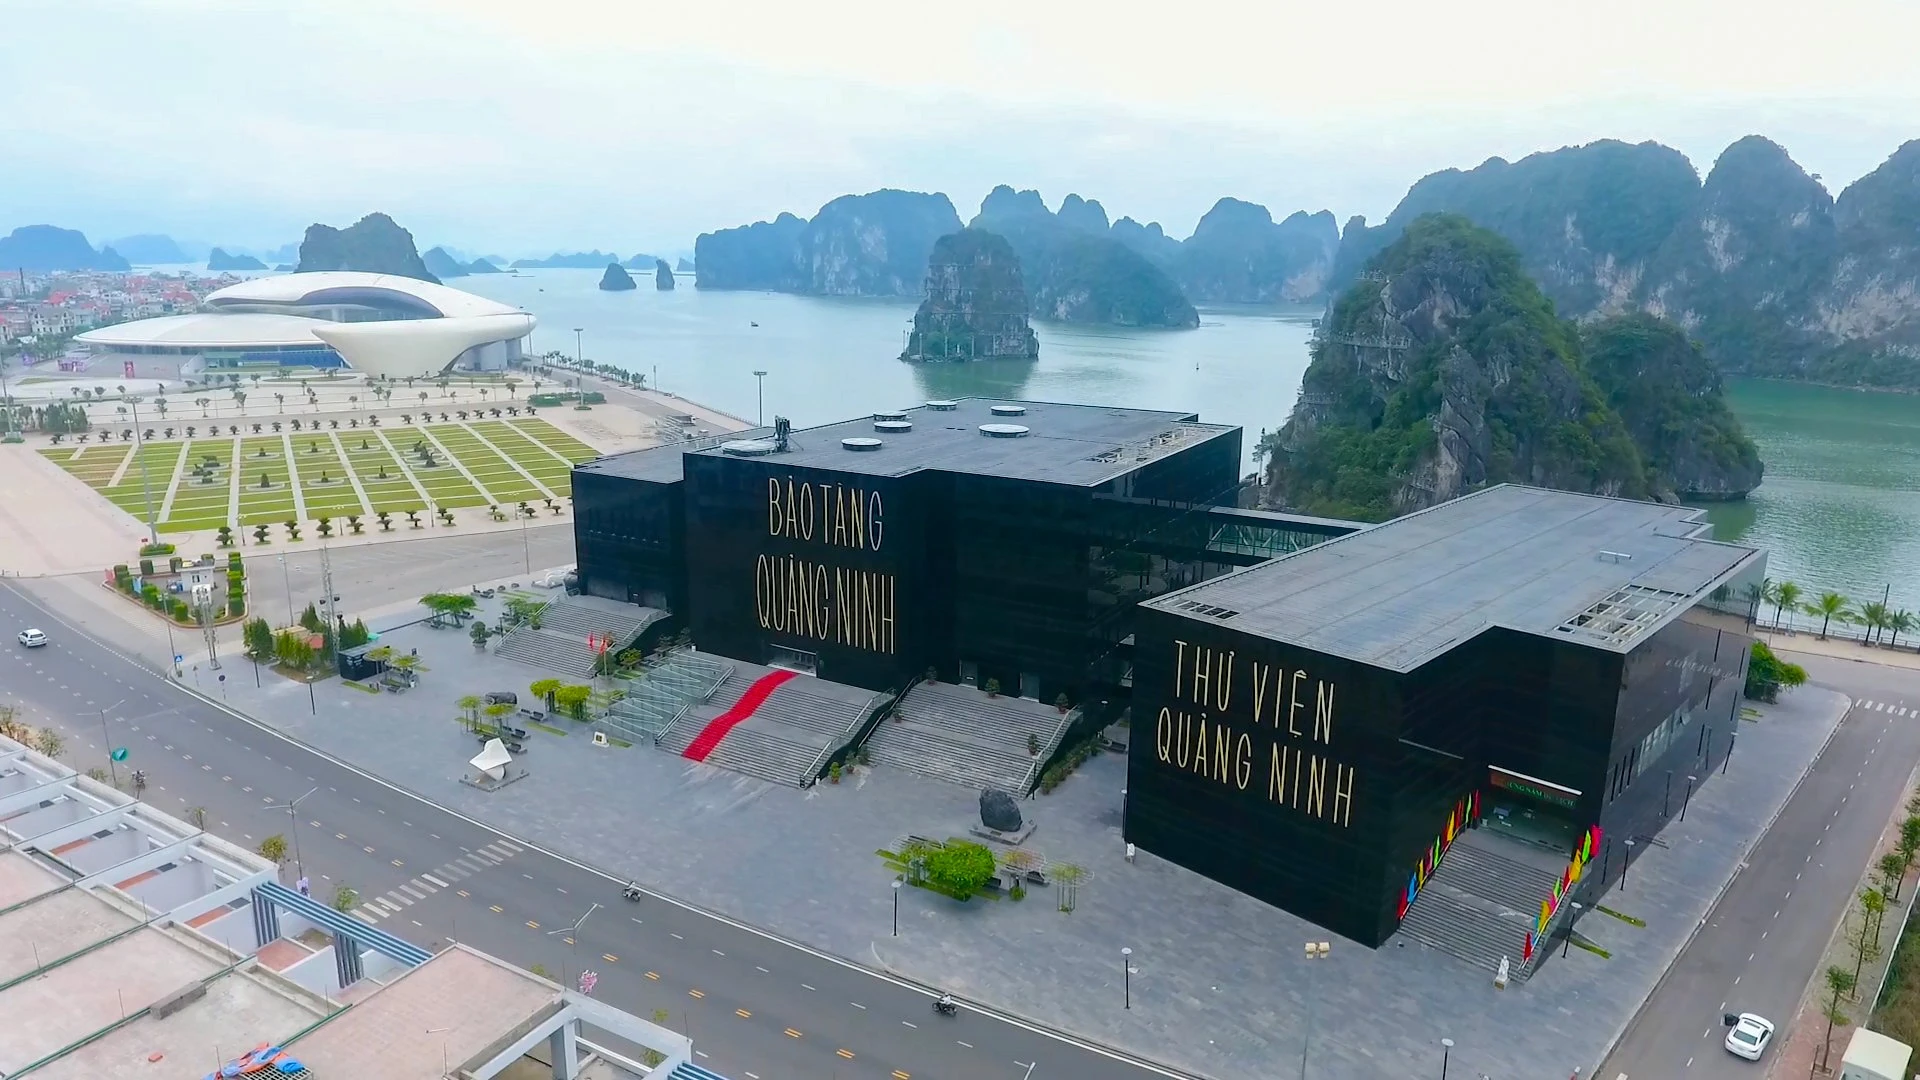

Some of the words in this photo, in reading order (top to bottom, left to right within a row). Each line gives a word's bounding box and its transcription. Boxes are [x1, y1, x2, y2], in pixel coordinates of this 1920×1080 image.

[769, 475, 814, 541] BẢO
[819, 482, 883, 551] TÀNG
[756, 553, 829, 640] QUẢNG
[836, 566, 894, 655] NINH
[1174, 639, 1235, 712] THƯ
[1253, 661, 1335, 745] VIỆN
[1157, 706, 1251, 790] QUẢNG
[1269, 742, 1354, 828] NINH
